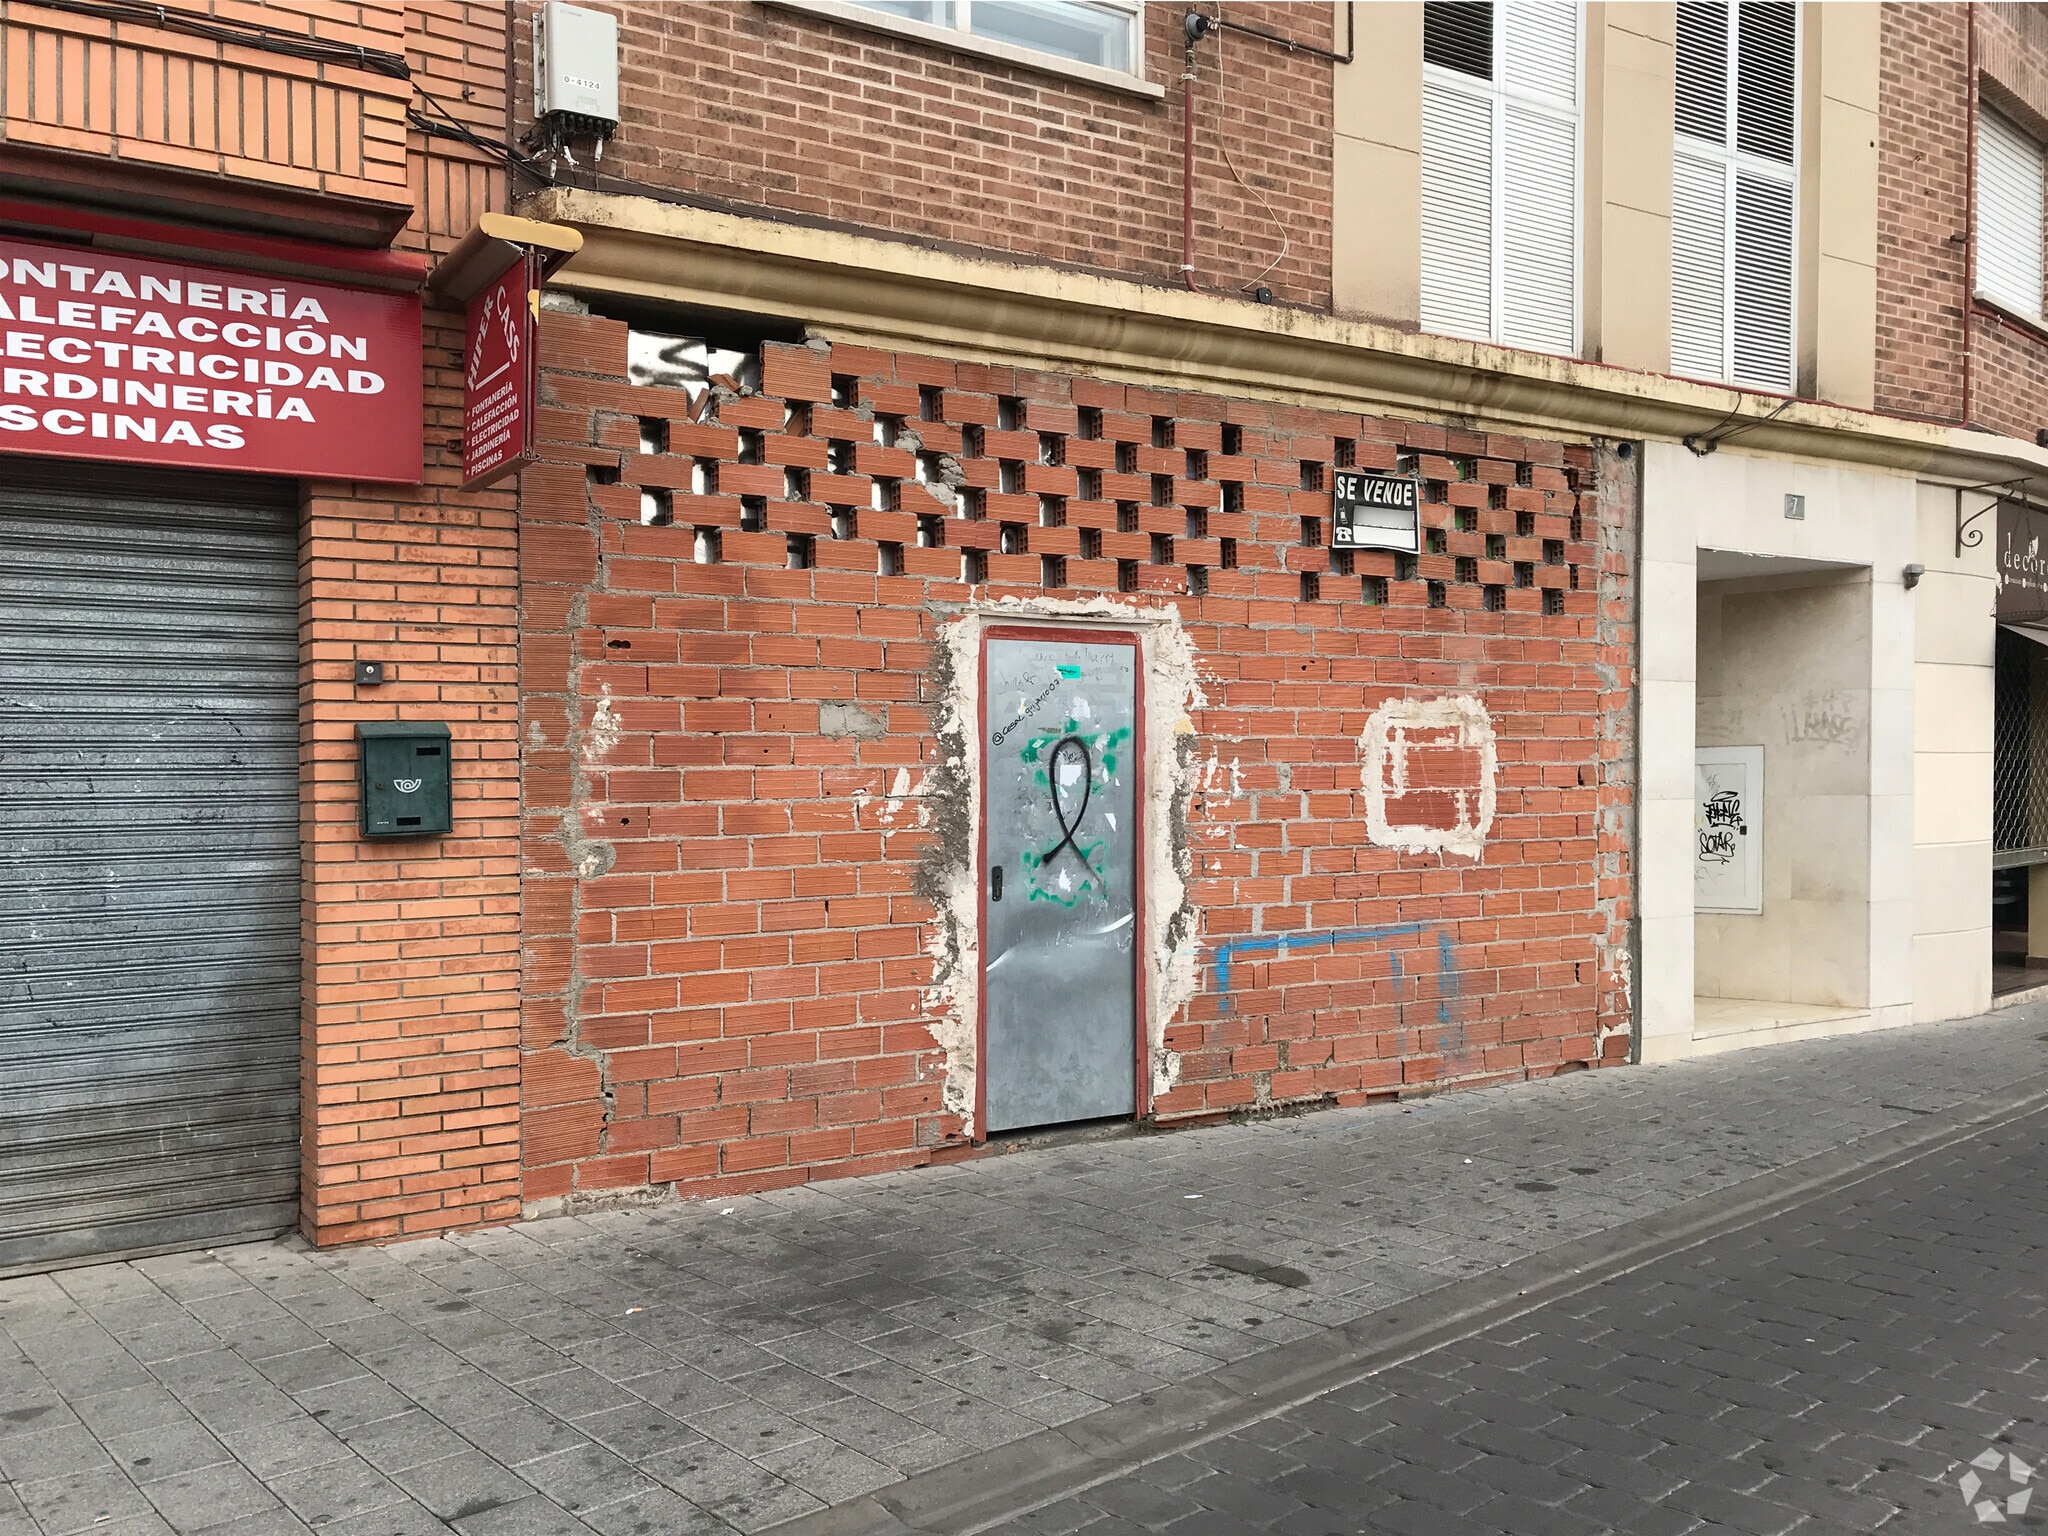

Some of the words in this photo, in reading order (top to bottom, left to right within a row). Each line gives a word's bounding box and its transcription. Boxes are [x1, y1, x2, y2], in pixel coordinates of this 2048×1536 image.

[0, 258, 329, 323] NTANERÍA
[467, 295, 494, 392] HIPER
[496, 285, 520, 363] CASS
[0, 331, 385, 395] ECTRICIDAD
[471, 381, 513, 417] FONTANERÍA
[471, 393, 518, 431] CALEFACCIÓN
[470, 429, 511, 461] JARDINERÍA
[471, 408, 520, 447] ELECTRICIDAD
[470, 449, 503, 476] PISCINAS
[1337, 475, 1358, 500] SE
[1364, 479, 1413, 506] VENDE
